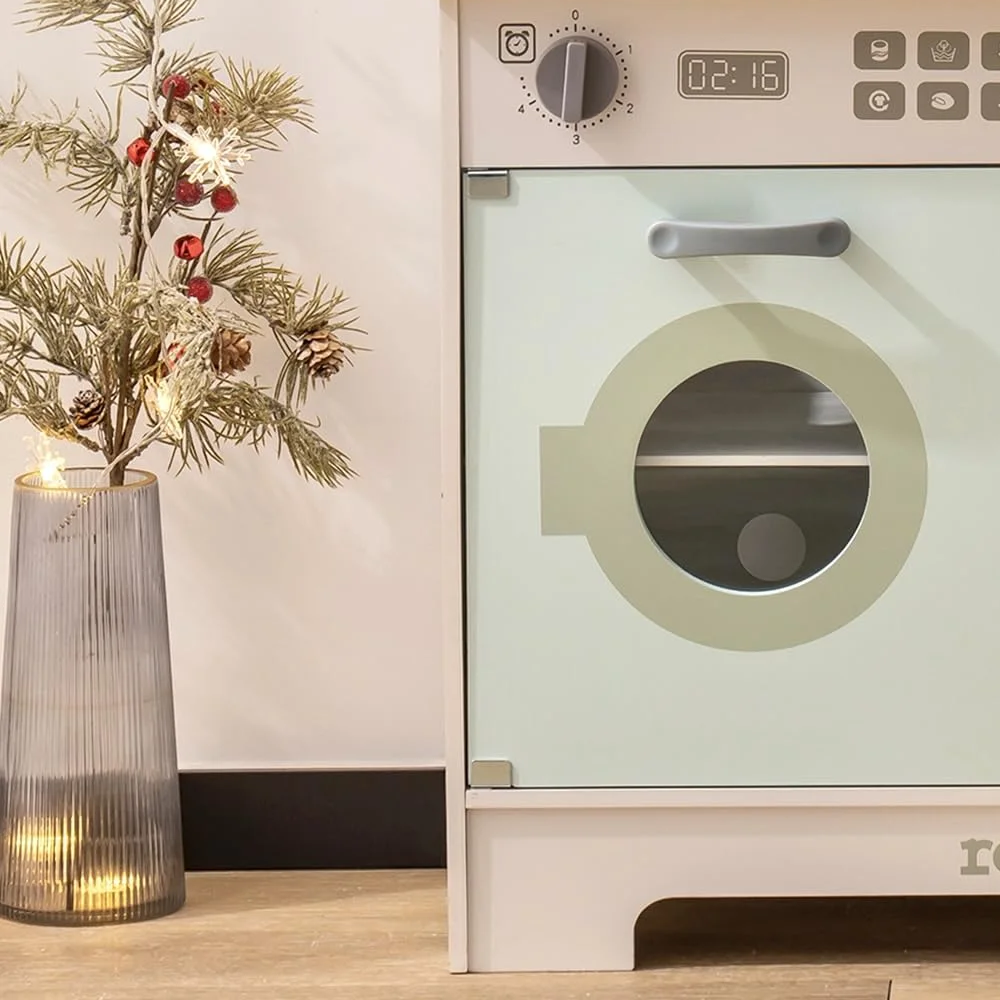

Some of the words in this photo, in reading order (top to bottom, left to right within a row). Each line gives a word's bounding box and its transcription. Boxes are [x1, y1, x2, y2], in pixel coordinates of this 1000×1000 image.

[571, 9, 579, 20] 0
[627, 44, 632, 54] 1
[688, 59, 779, 91] 02:16
[517, 104, 525, 113] 4
[626, 103, 634, 114] 2
[572, 134, 580, 145] 3
